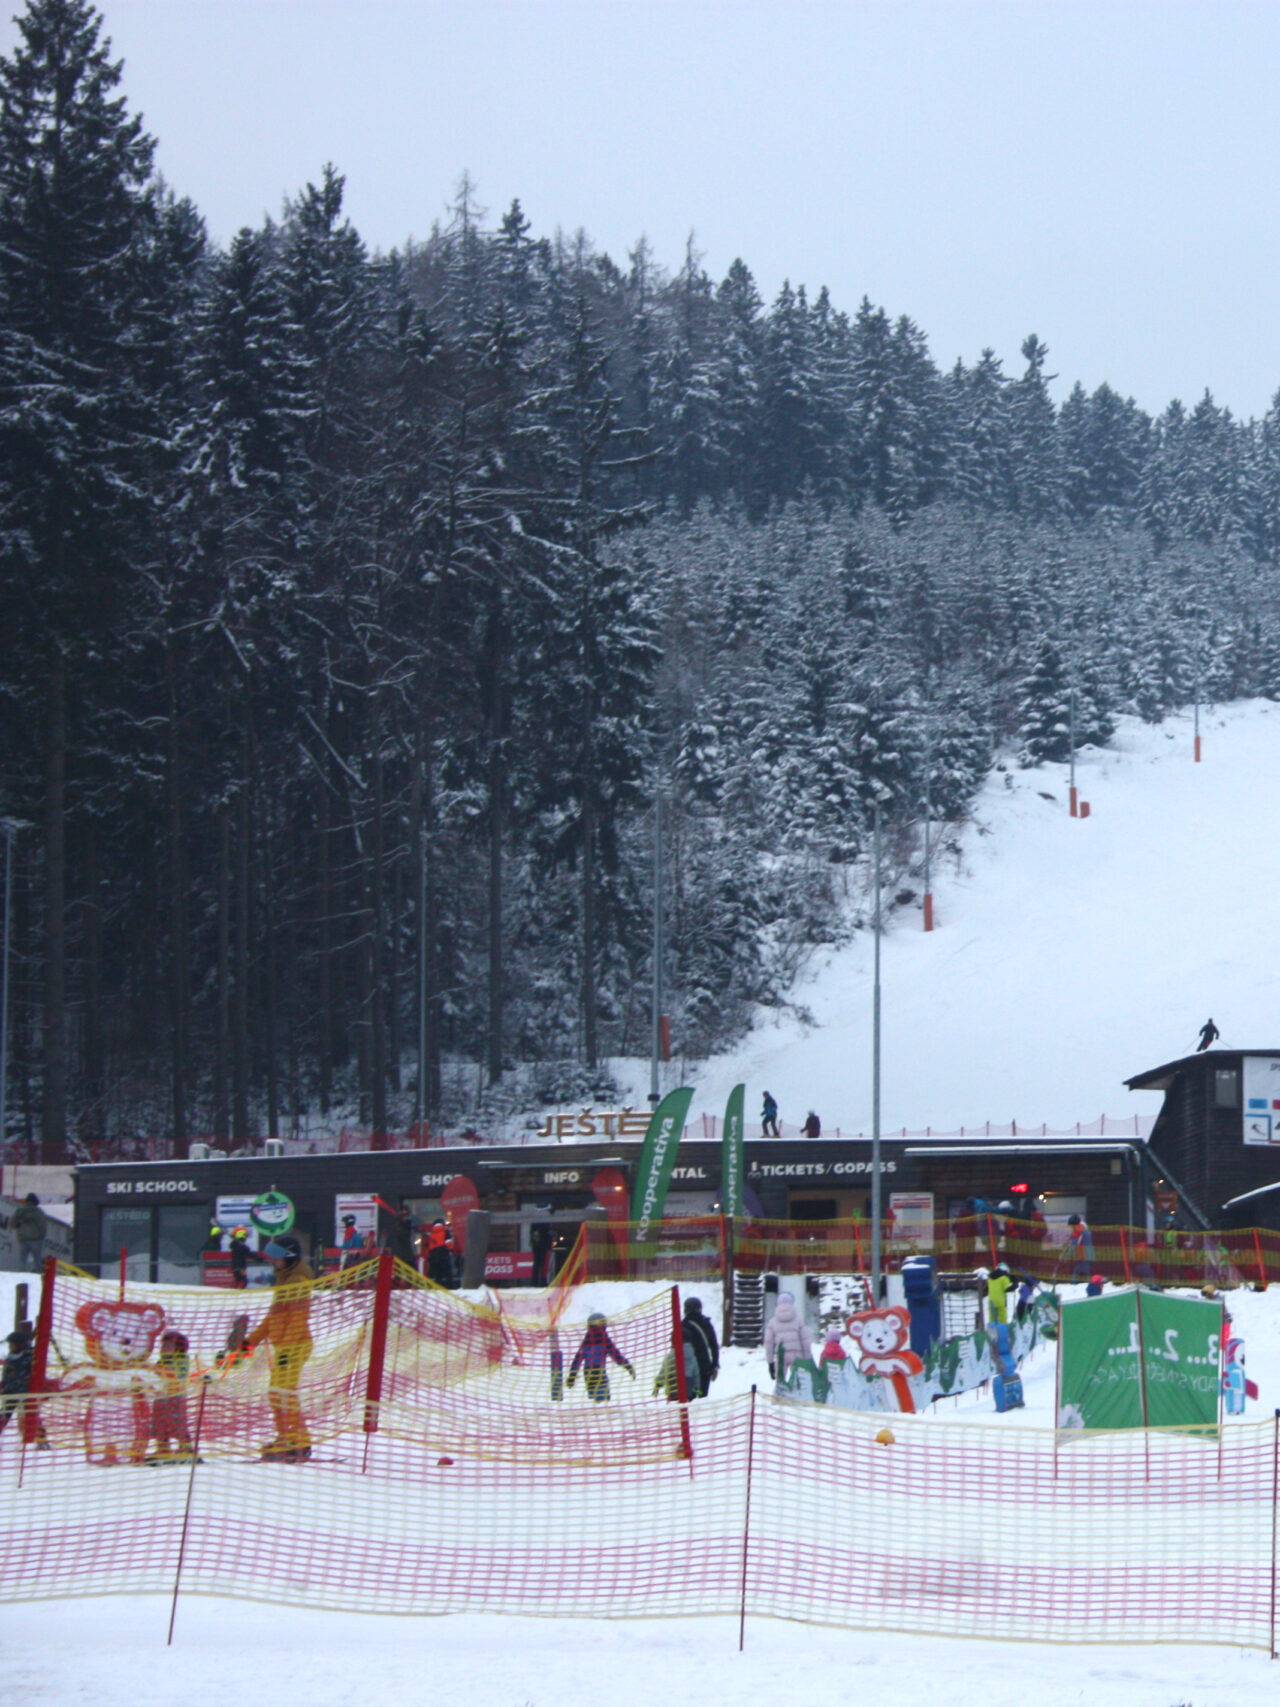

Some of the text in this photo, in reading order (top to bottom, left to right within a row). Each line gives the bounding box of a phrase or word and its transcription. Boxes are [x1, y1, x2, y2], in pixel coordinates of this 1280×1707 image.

[537, 1106, 656, 1138] JEŠTĚ
[422, 1174, 463, 1187] SHO
[544, 1172, 580, 1184] INFO
[636, 1116, 675, 1241] Kooperativa
[106, 1180, 198, 1194] SKI SCHOOL
